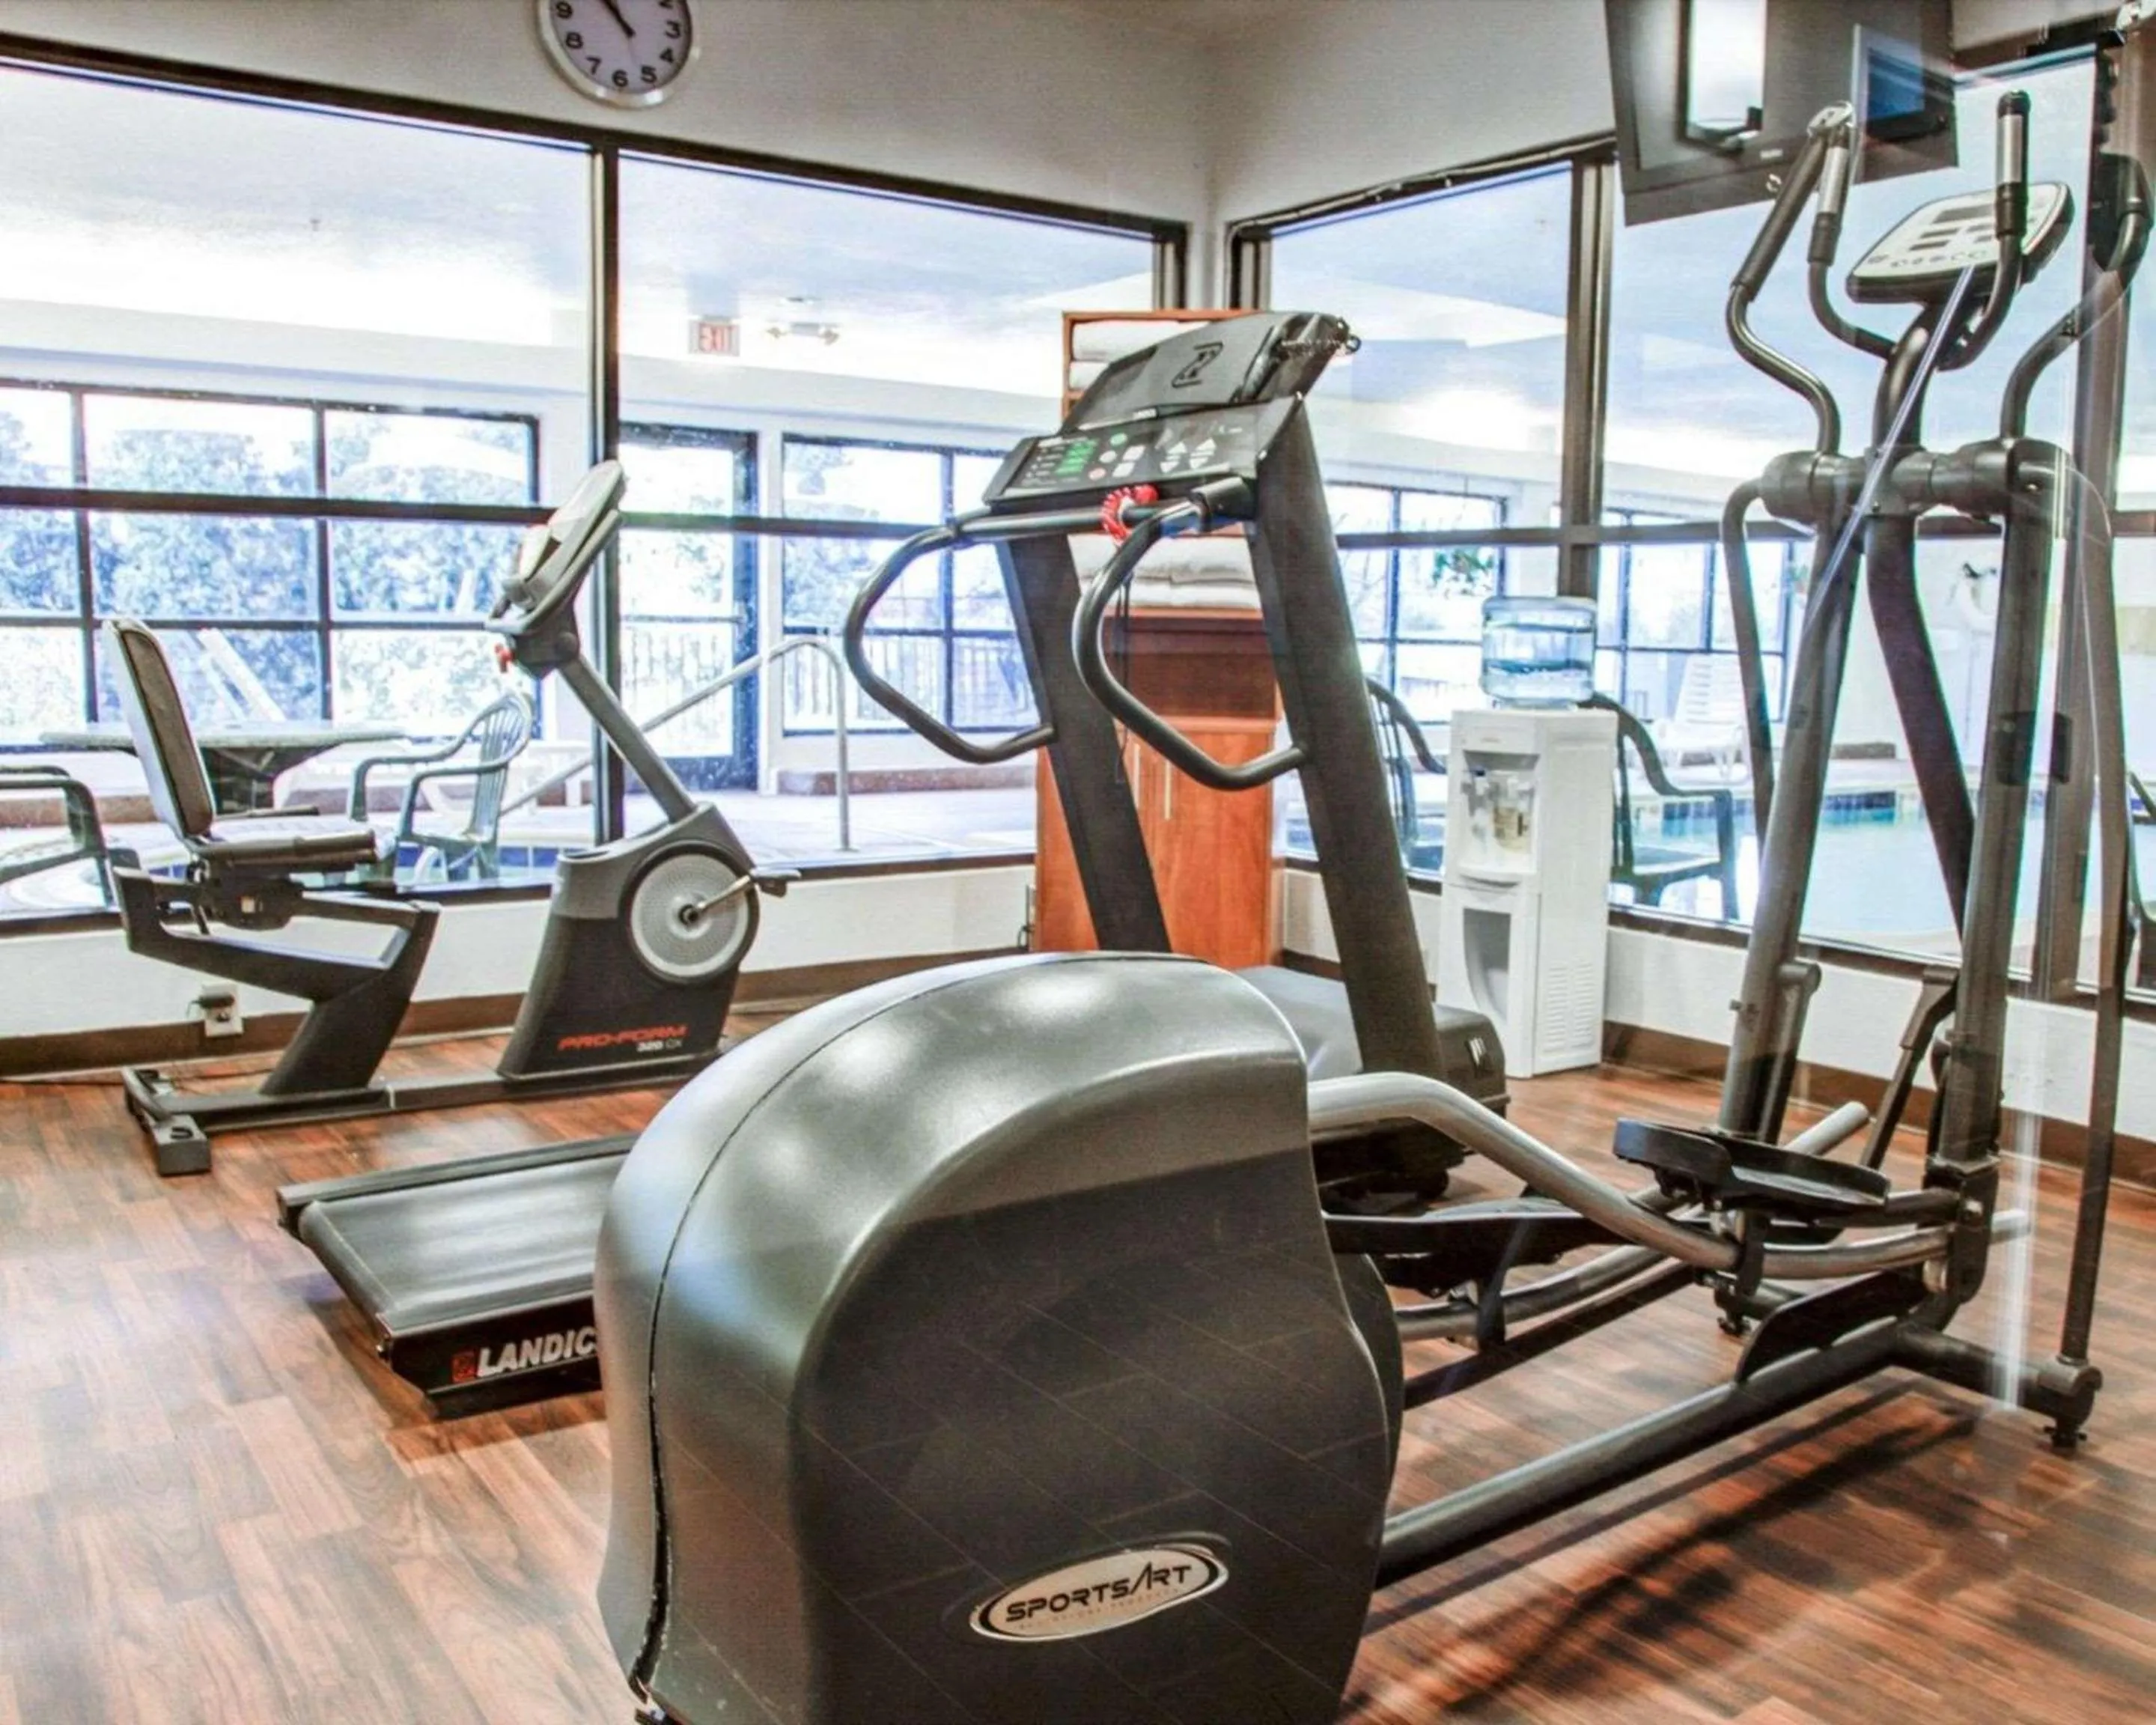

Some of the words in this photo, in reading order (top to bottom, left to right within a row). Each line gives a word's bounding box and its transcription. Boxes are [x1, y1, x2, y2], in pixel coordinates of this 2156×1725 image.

[555, 2, 573, 19] 9
[665, 20, 680, 38] 3
[564, 32, 583, 49] 8
[586, 56, 602, 74] 7
[660, 48, 674, 64] 4
[611, 70, 629, 88] 6
[640, 65, 657, 84] 5
[698, 323, 736, 354] EXIT
[1005, 1561, 1191, 1623] SPORTSART
